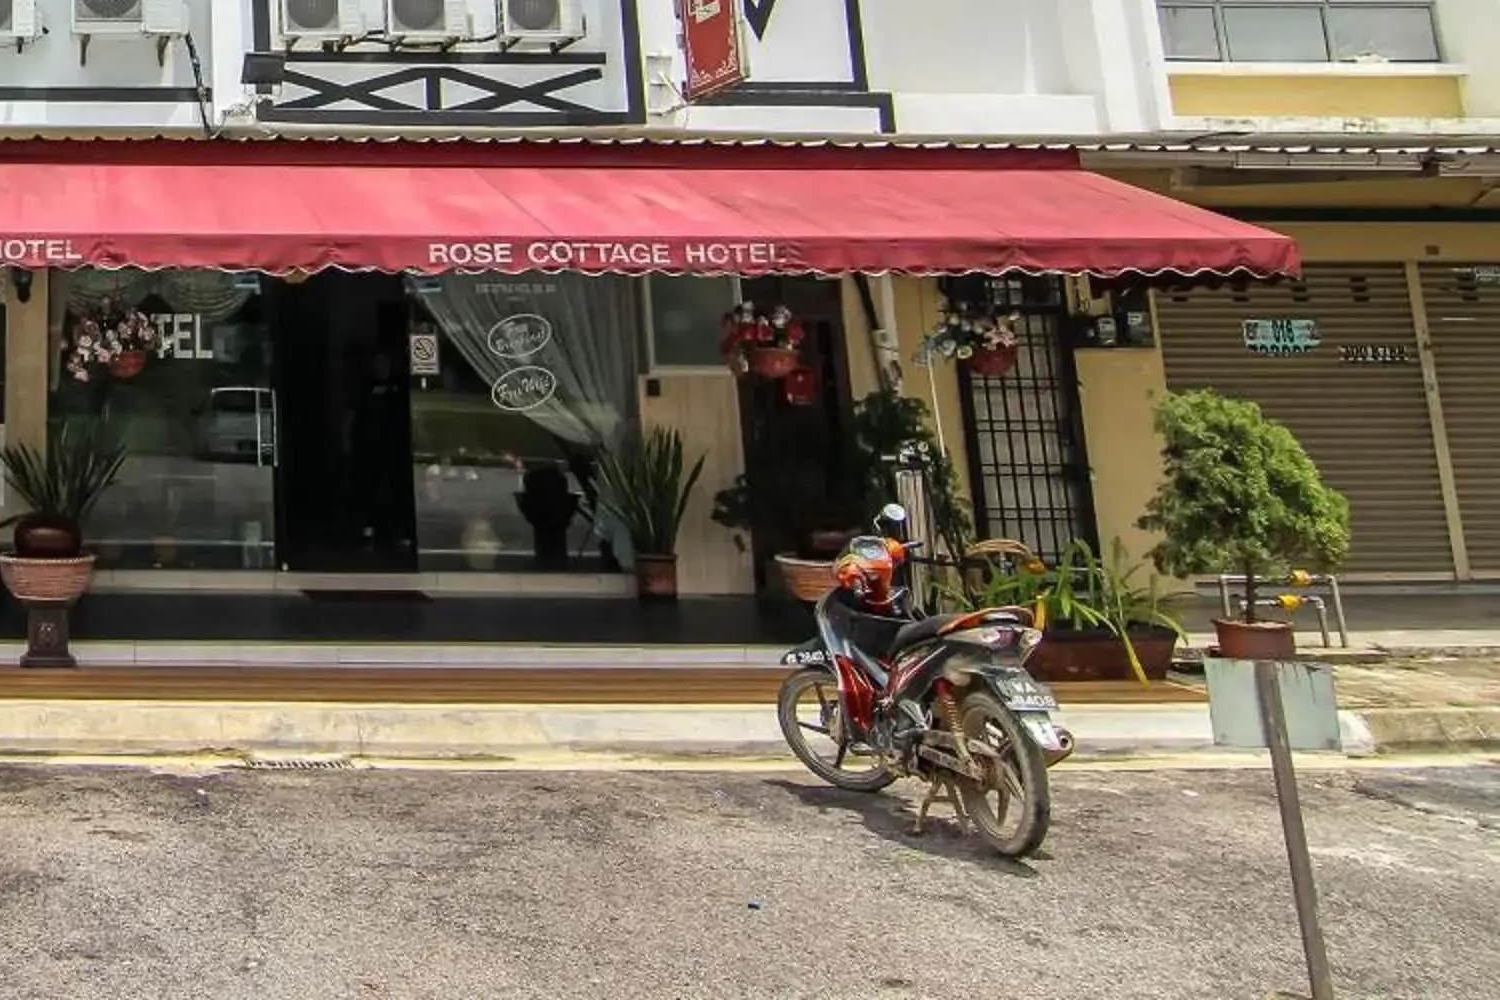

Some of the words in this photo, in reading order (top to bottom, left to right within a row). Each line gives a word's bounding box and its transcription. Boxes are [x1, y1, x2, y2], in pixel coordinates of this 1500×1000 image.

[428, 242, 513, 264] ROSE
[526, 242, 671, 264] COTTAGE
[686, 243, 787, 264] HOTEL
